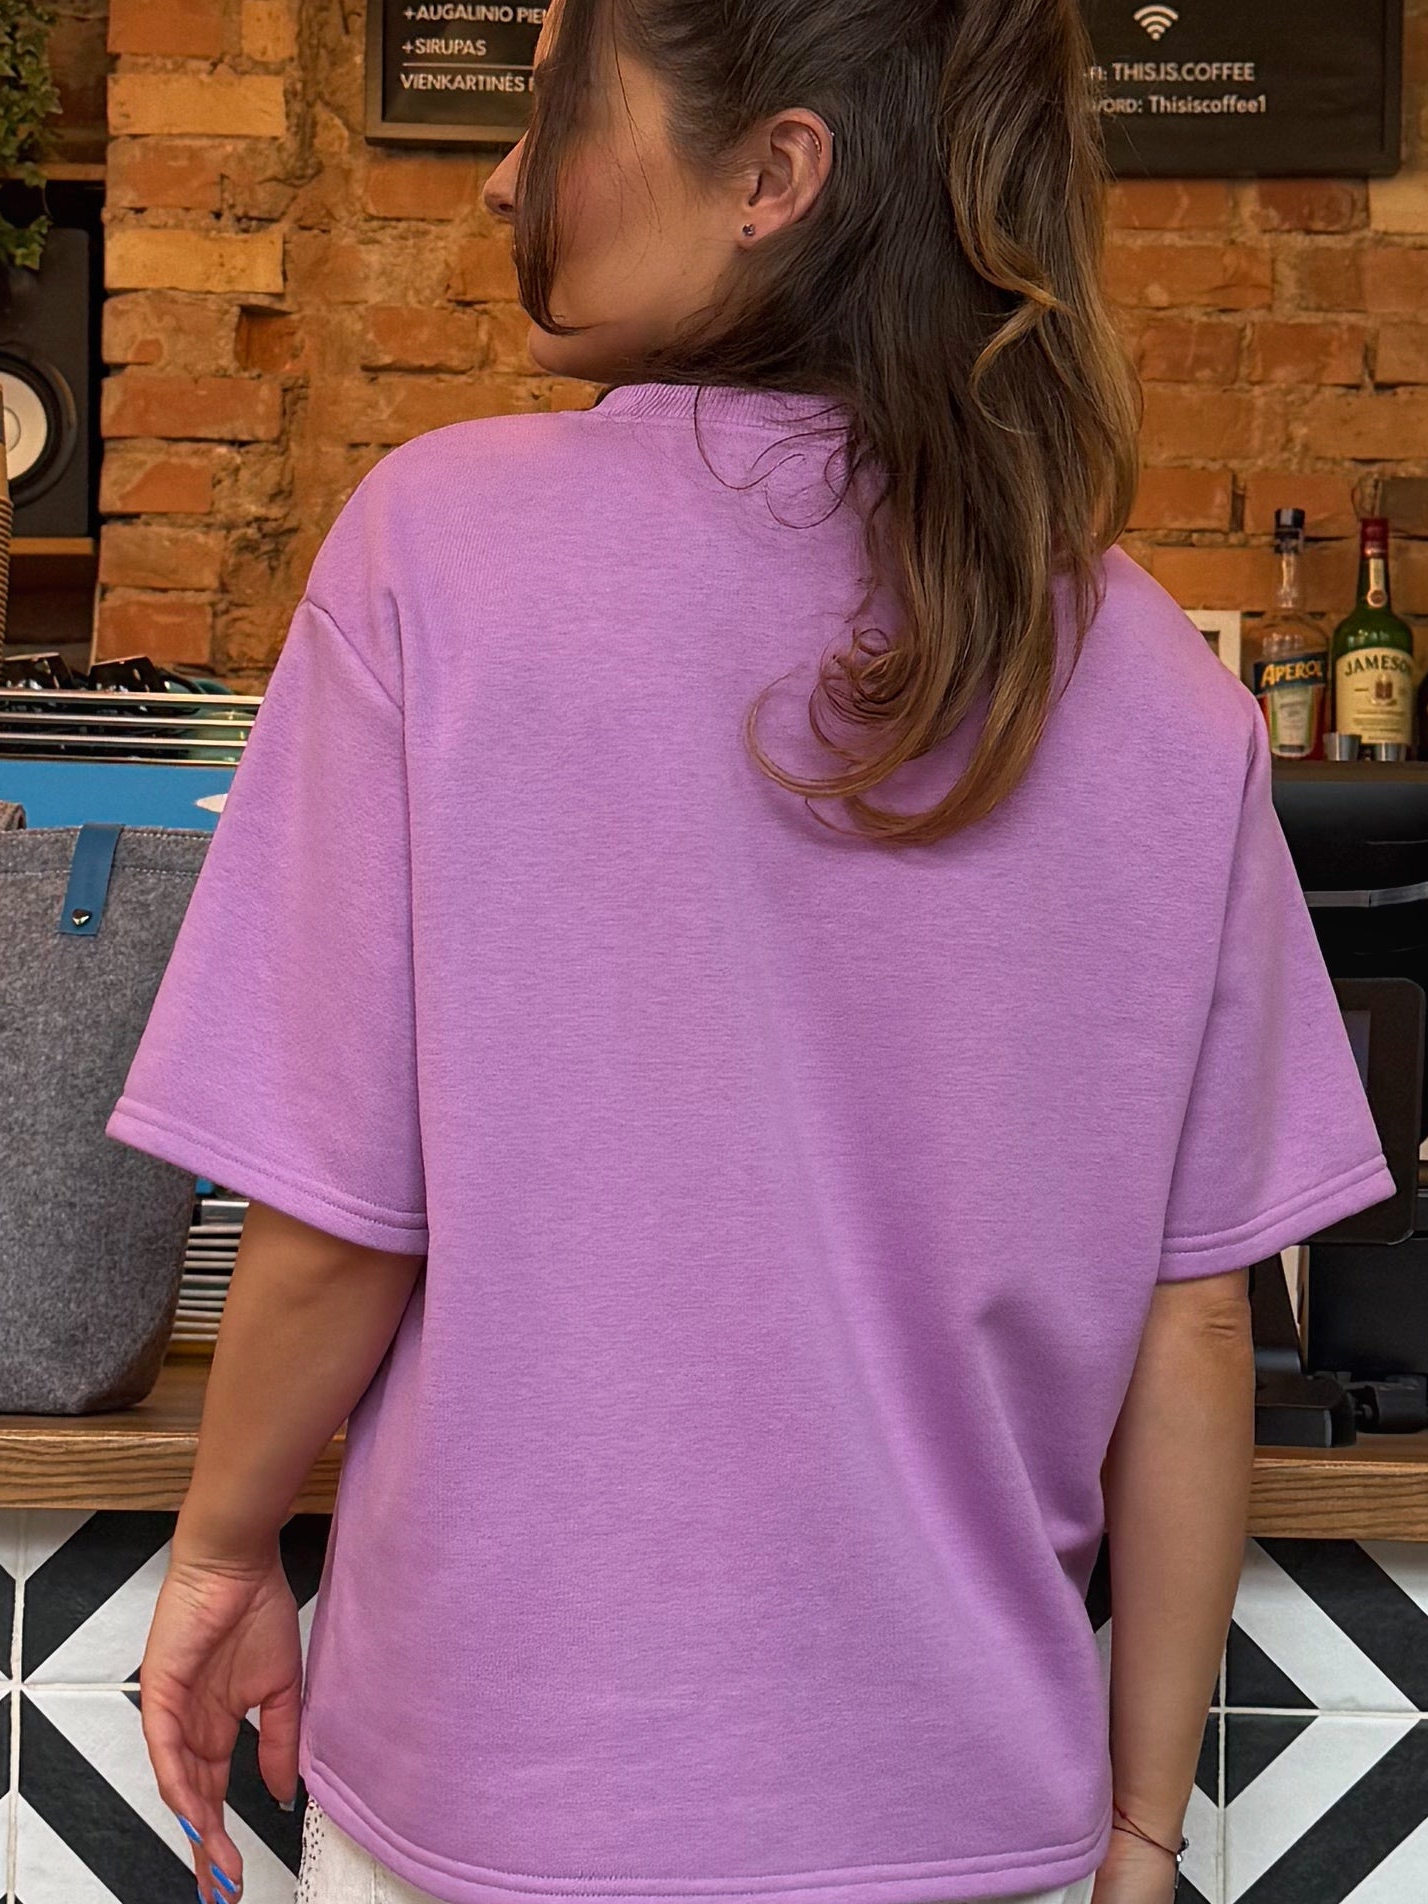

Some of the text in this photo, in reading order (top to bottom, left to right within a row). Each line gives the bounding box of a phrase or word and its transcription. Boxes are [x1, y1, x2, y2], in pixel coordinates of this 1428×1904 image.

[404, 3, 514, 23] +AUGALINIO
[402, 38, 487, 56] +SIRUPAS
[400, 71, 525, 91] VIENKARTINĖS
[1112, 62, 1256, 81] THIS.IS.COFFEE
[1148, 94, 1267, 114] Thisiscoffee1
